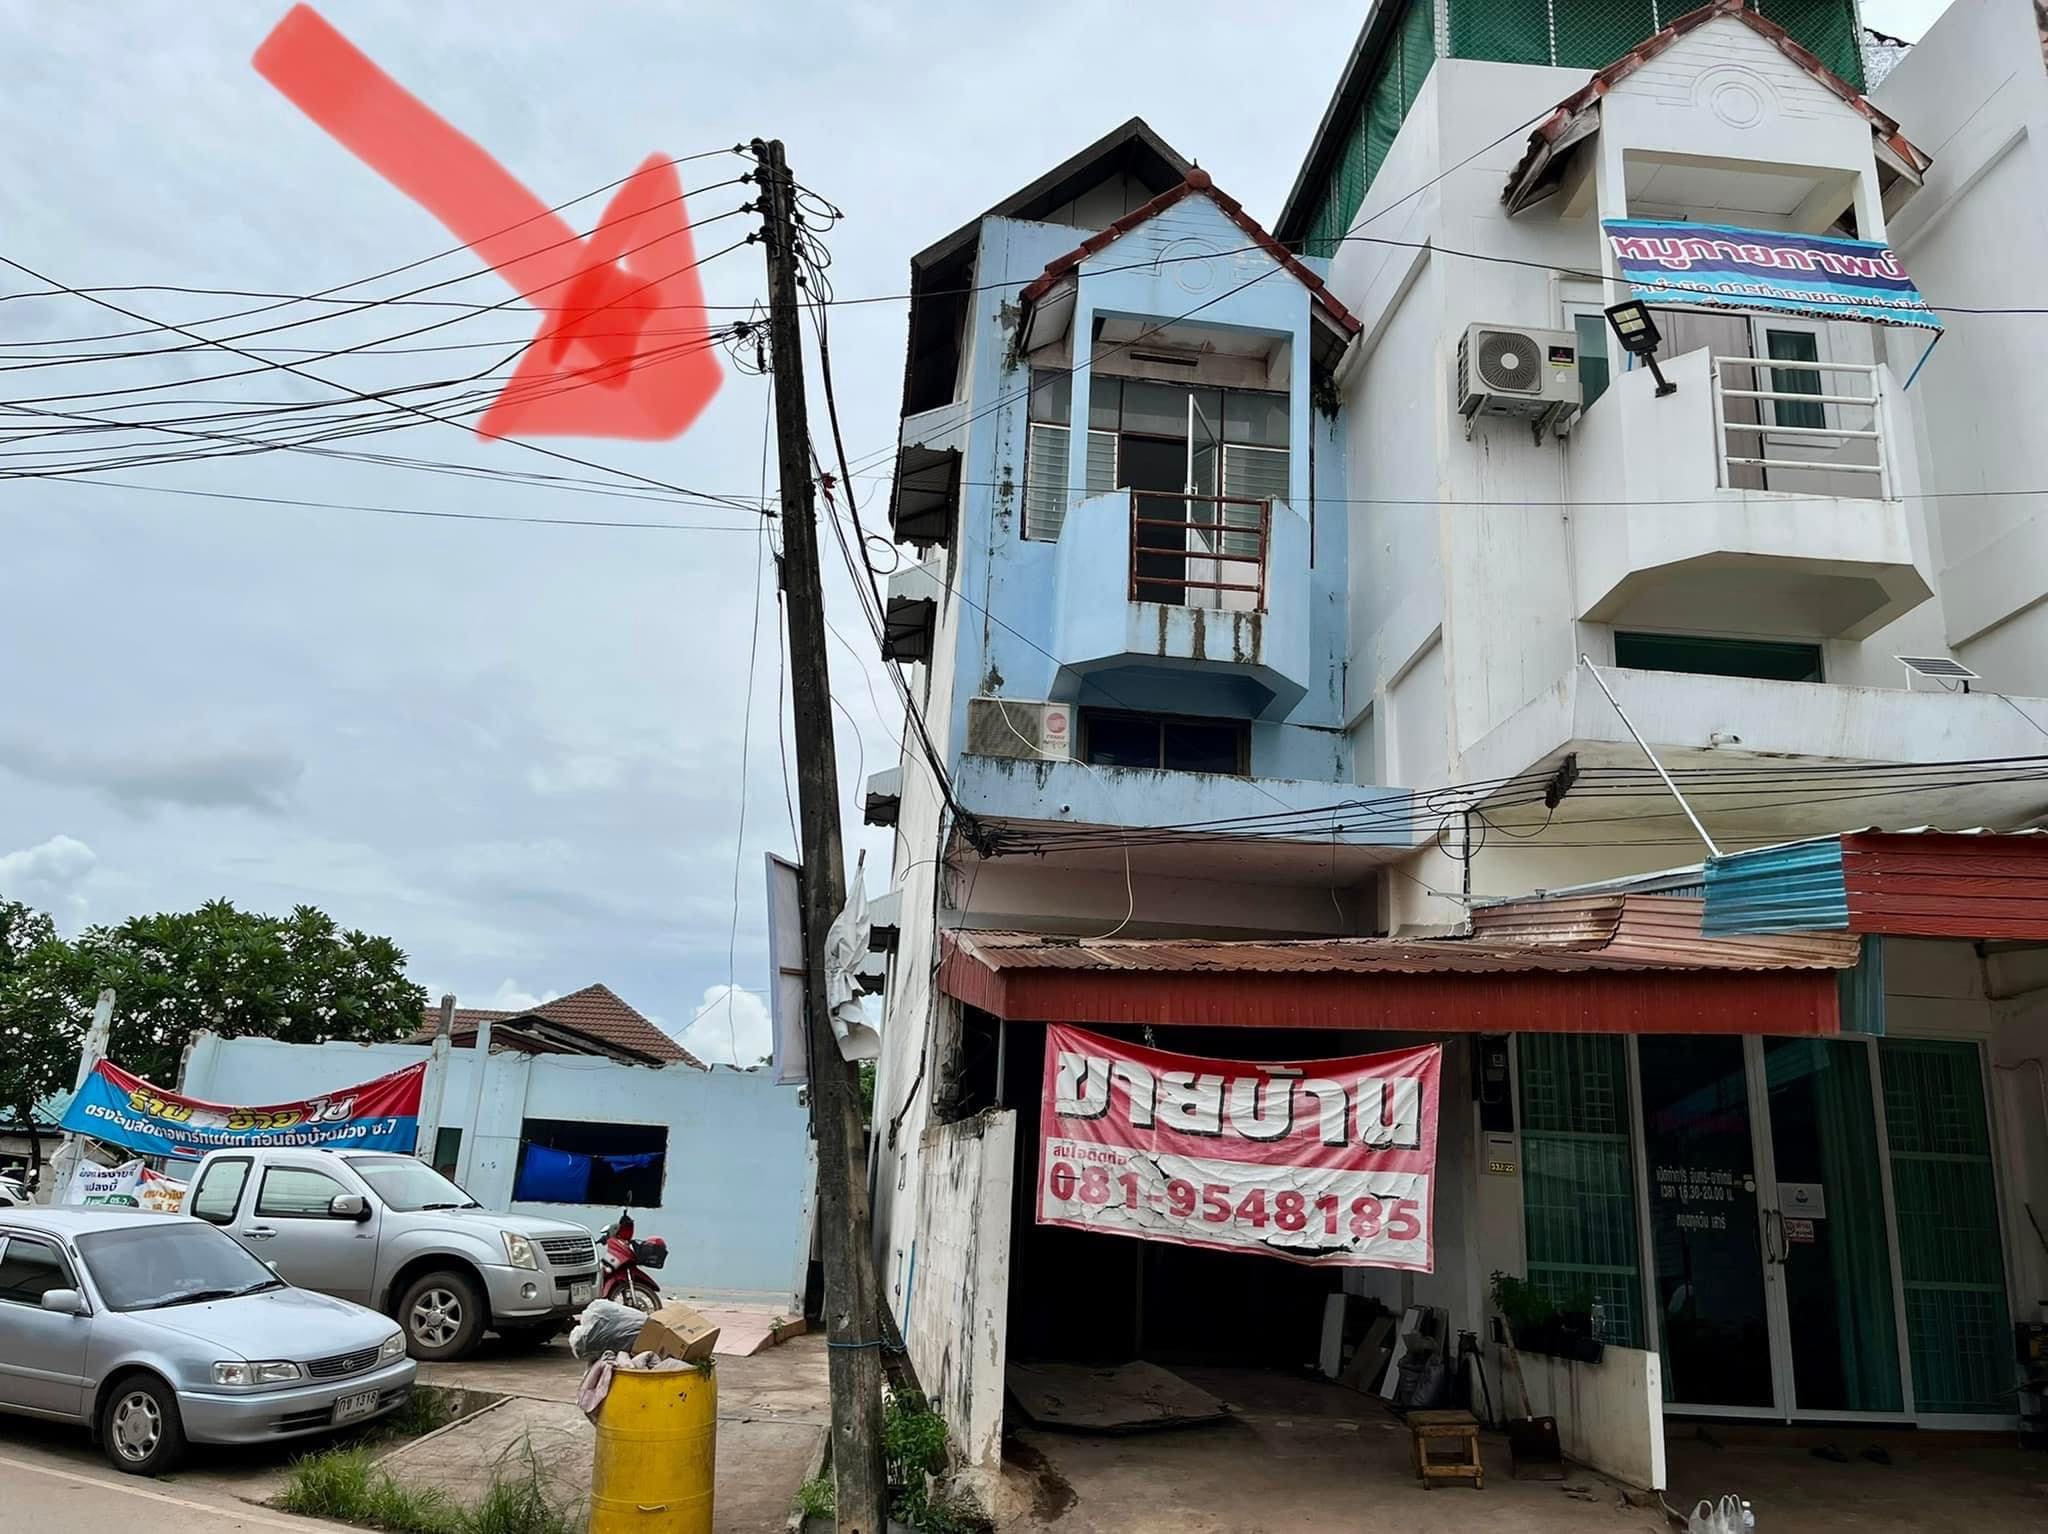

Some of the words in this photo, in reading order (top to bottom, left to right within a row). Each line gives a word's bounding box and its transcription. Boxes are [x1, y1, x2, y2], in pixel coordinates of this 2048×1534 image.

[304, 1093, 359, 1124] ไป
[1054, 1052, 1423, 1151] ขายบ้าน
[1050, 1161, 1422, 1241] 081-9548185
